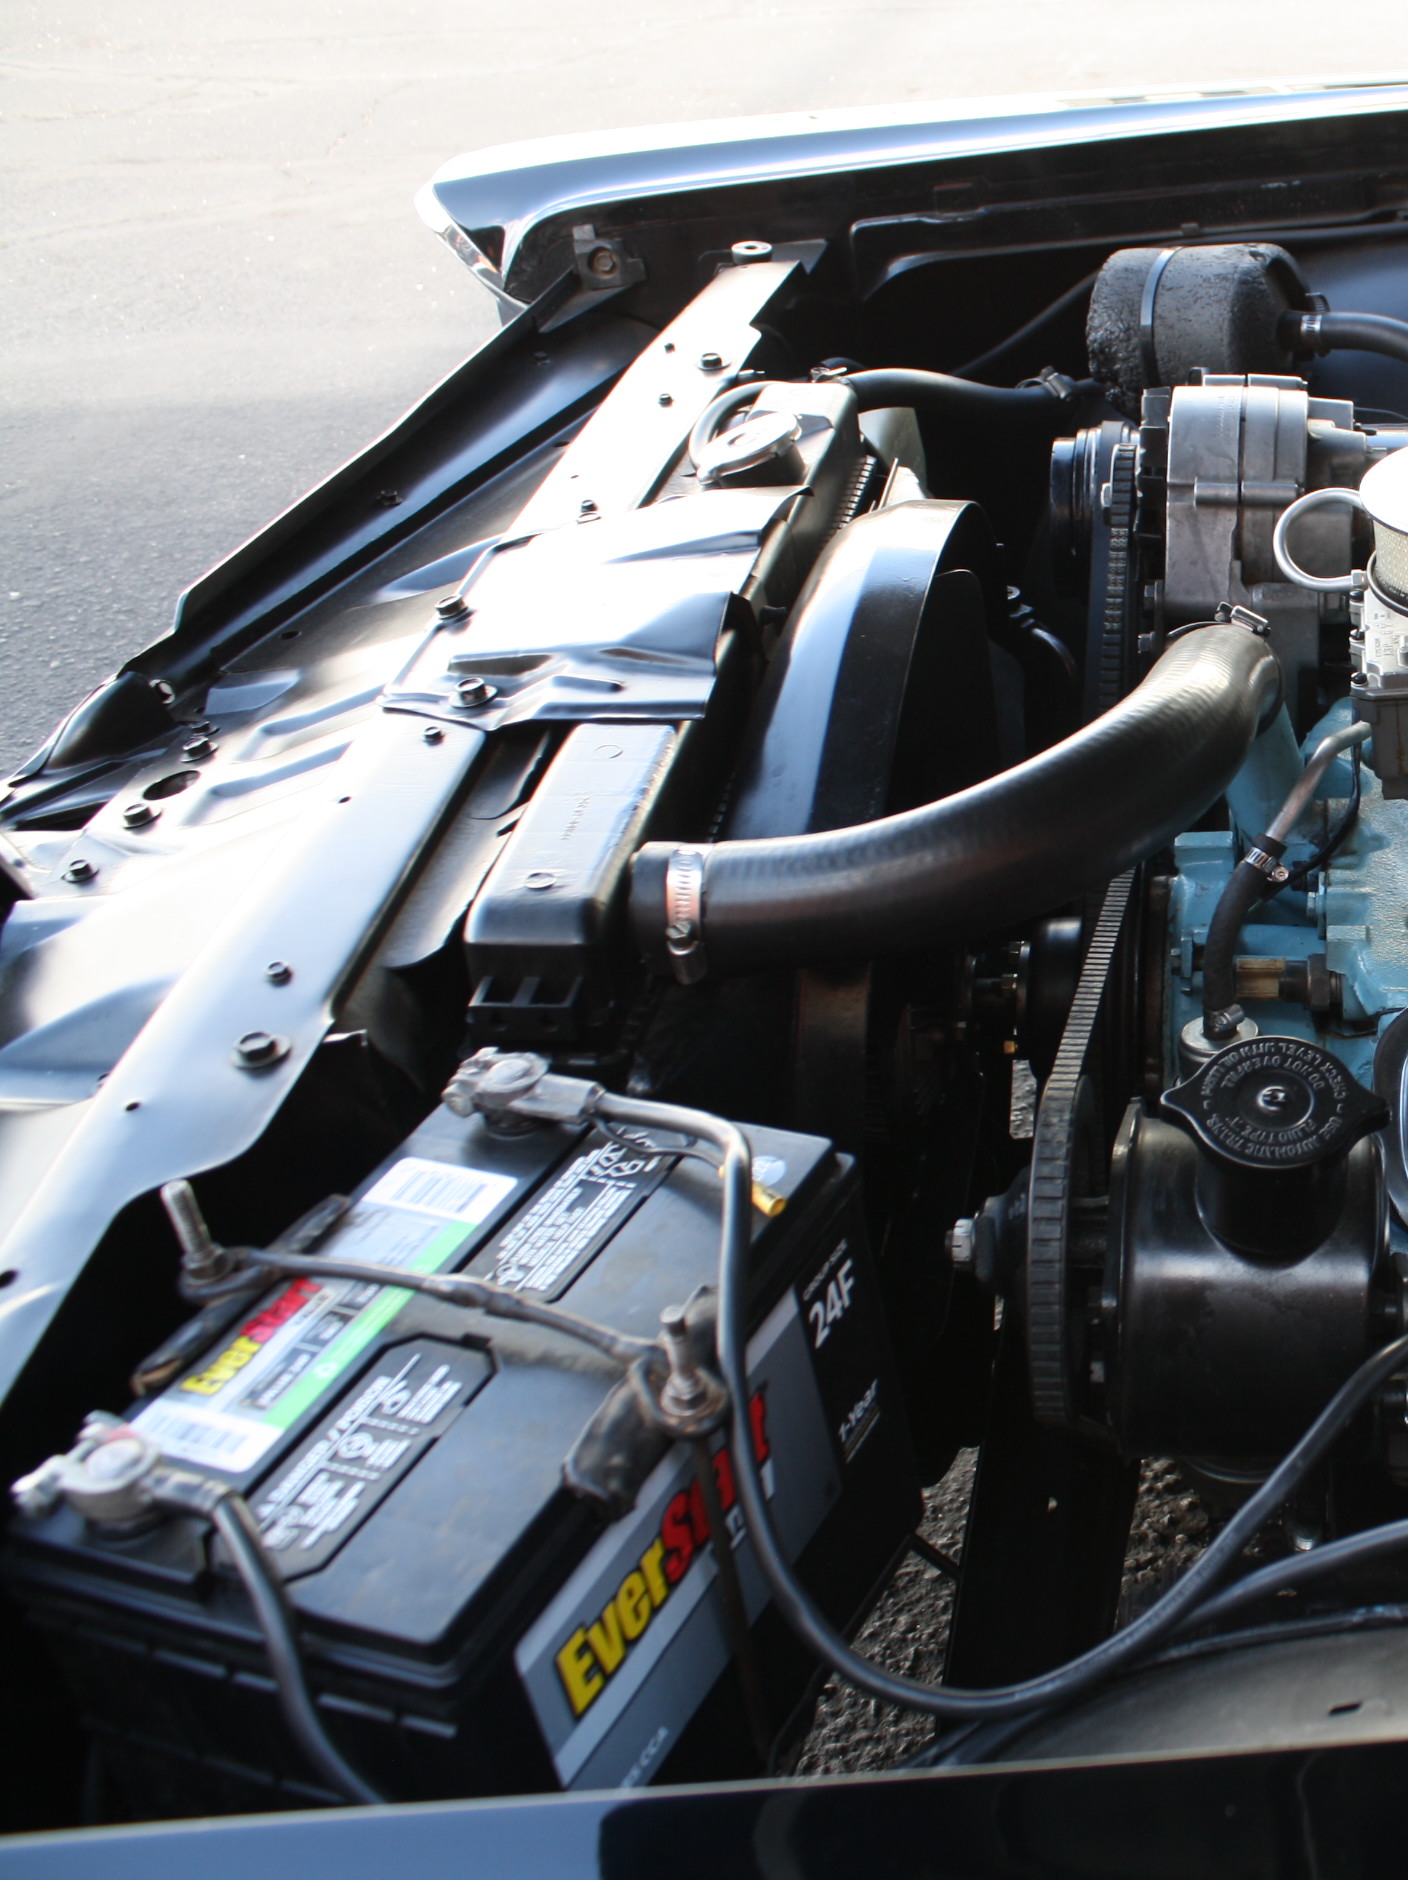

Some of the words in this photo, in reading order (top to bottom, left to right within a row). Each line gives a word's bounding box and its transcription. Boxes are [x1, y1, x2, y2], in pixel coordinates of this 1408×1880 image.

[1218, 1051, 1240, 1067] OIL
[1278, 1042, 1321, 1065] LEVEL
[1220, 1055, 1281, 1088] OVERFILL
[1283, 1057, 1313, 1076] NOT
[1308, 1073, 1326, 1091] DO
[1320, 1062, 1347, 1099] CHECK
[1241, 1124, 1275, 1144] TYPE
[1278, 1118, 1317, 1142] FLUID
[1318, 1116, 1343, 1139] USE
[1245, 1135, 1320, 1159] AUTOMATIC
[808, 1258, 855, 1349] 24F
[179, 1277, 325, 1395] EverStart
[335, 1374, 393, 1431] POISON
[838, 1378, 879, 1442] 1-Year
[634, 1724, 670, 1767] CCA
